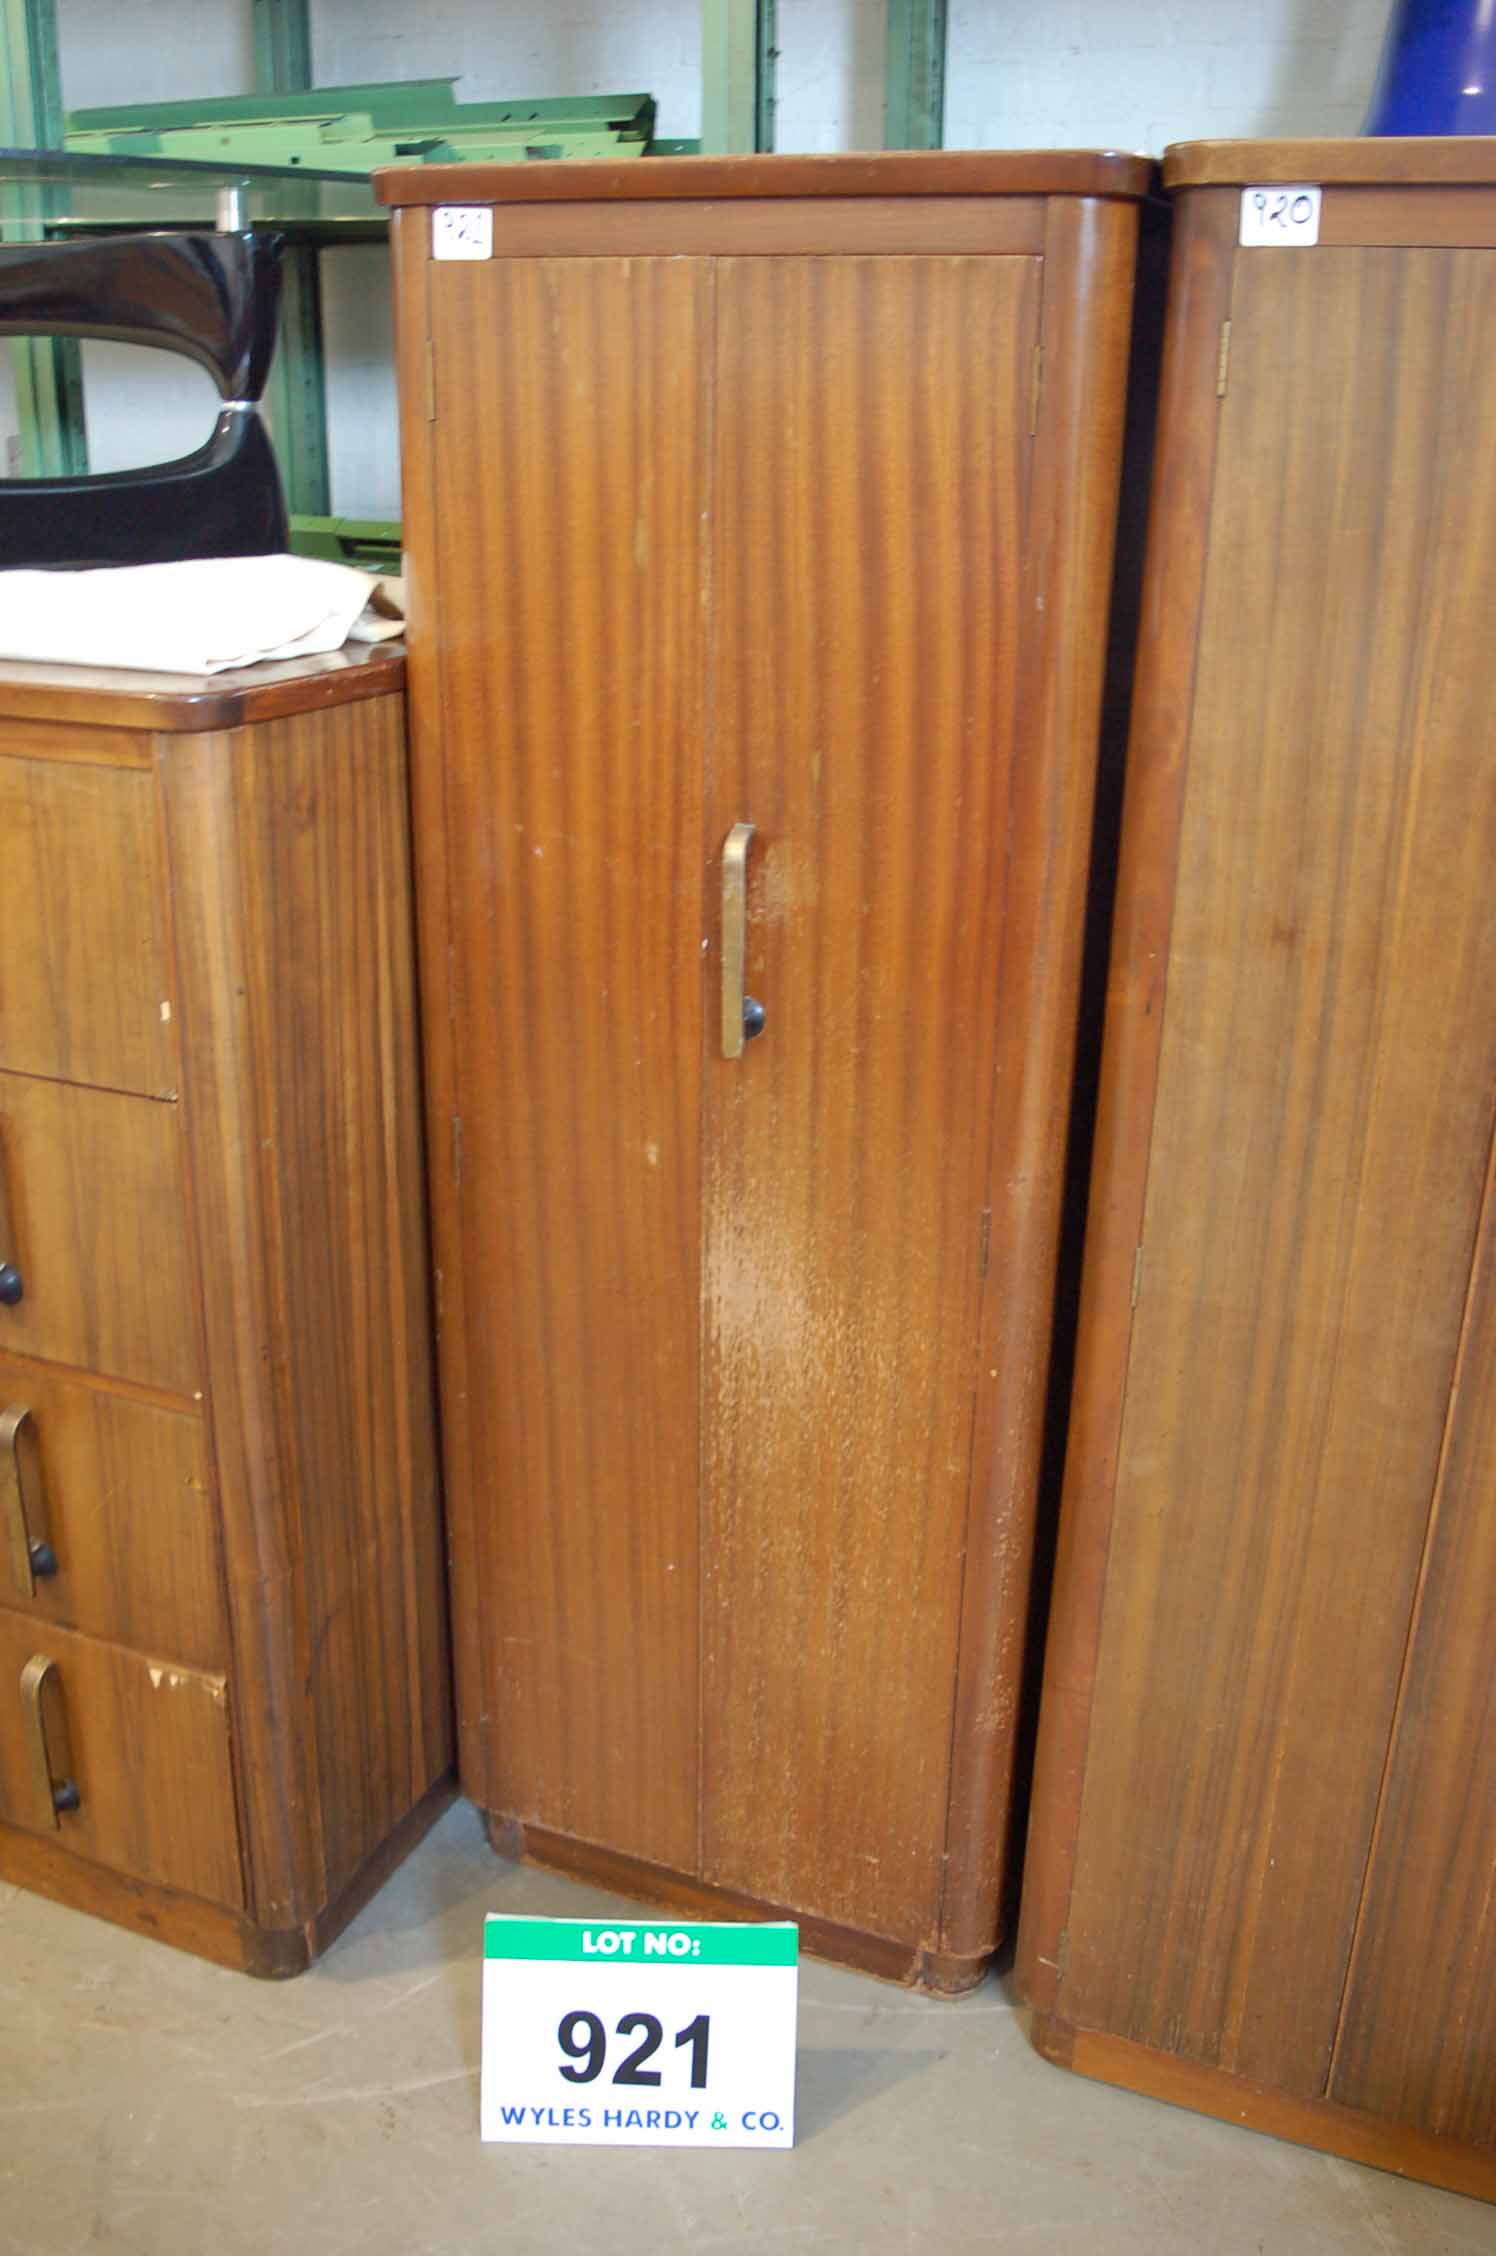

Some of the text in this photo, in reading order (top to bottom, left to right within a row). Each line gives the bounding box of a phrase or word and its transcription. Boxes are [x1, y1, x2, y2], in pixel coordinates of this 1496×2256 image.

[1253, 191, 1313, 228] 920
[582, 1931, 702, 1956] LOT NO:
[557, 2010, 711, 2089] 921
[501, 2107, 784, 2131] WYLES HARDY & CO.
